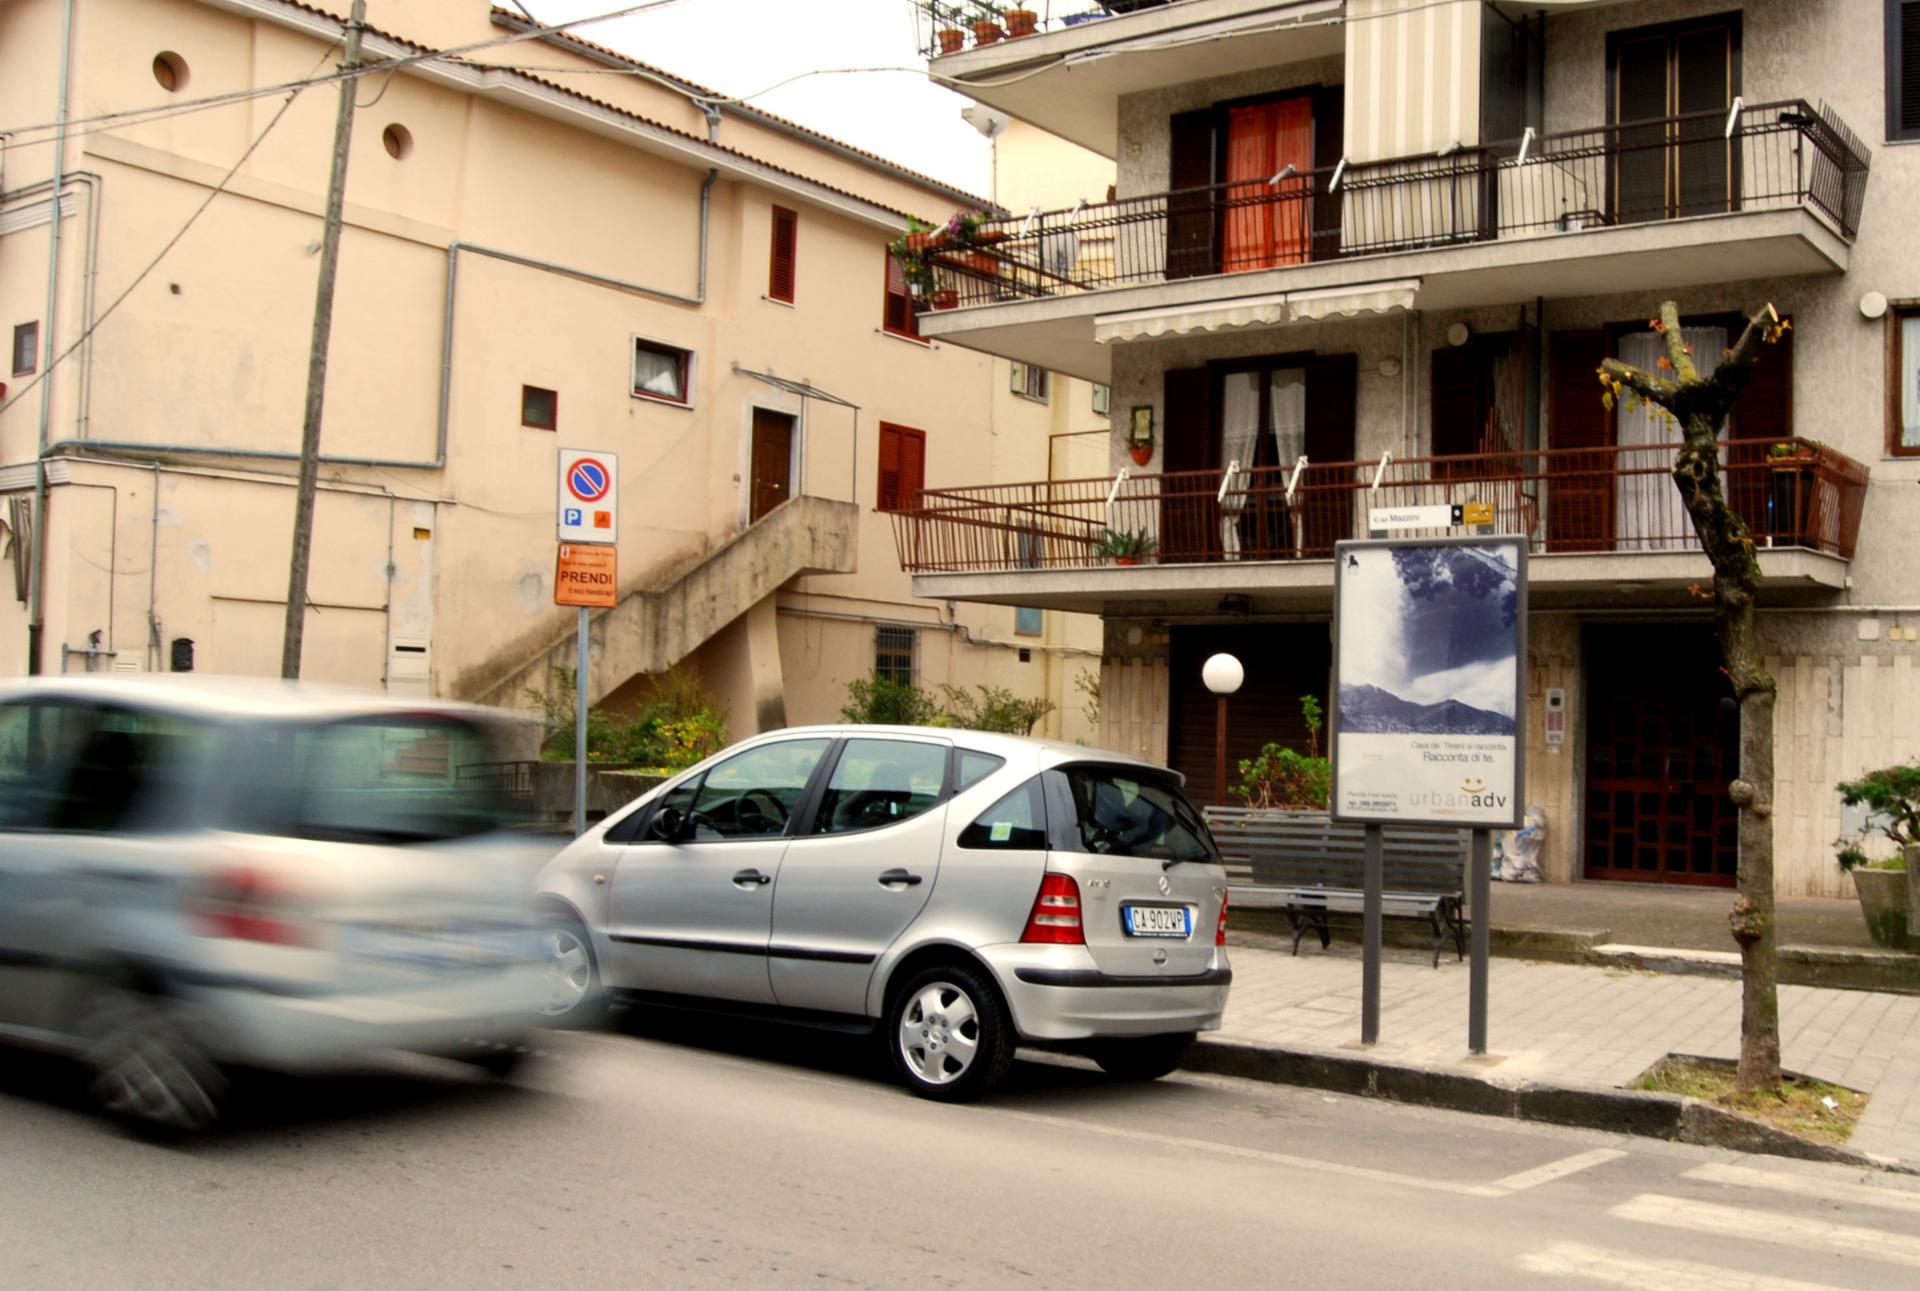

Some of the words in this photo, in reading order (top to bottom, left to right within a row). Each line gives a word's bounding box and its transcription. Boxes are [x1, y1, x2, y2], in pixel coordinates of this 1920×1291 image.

[567, 510, 579, 524] P
[560, 570, 613, 585] PRENDI
[1423, 751, 1469, 762] Racconta
[1471, 753, 1480, 762] di
